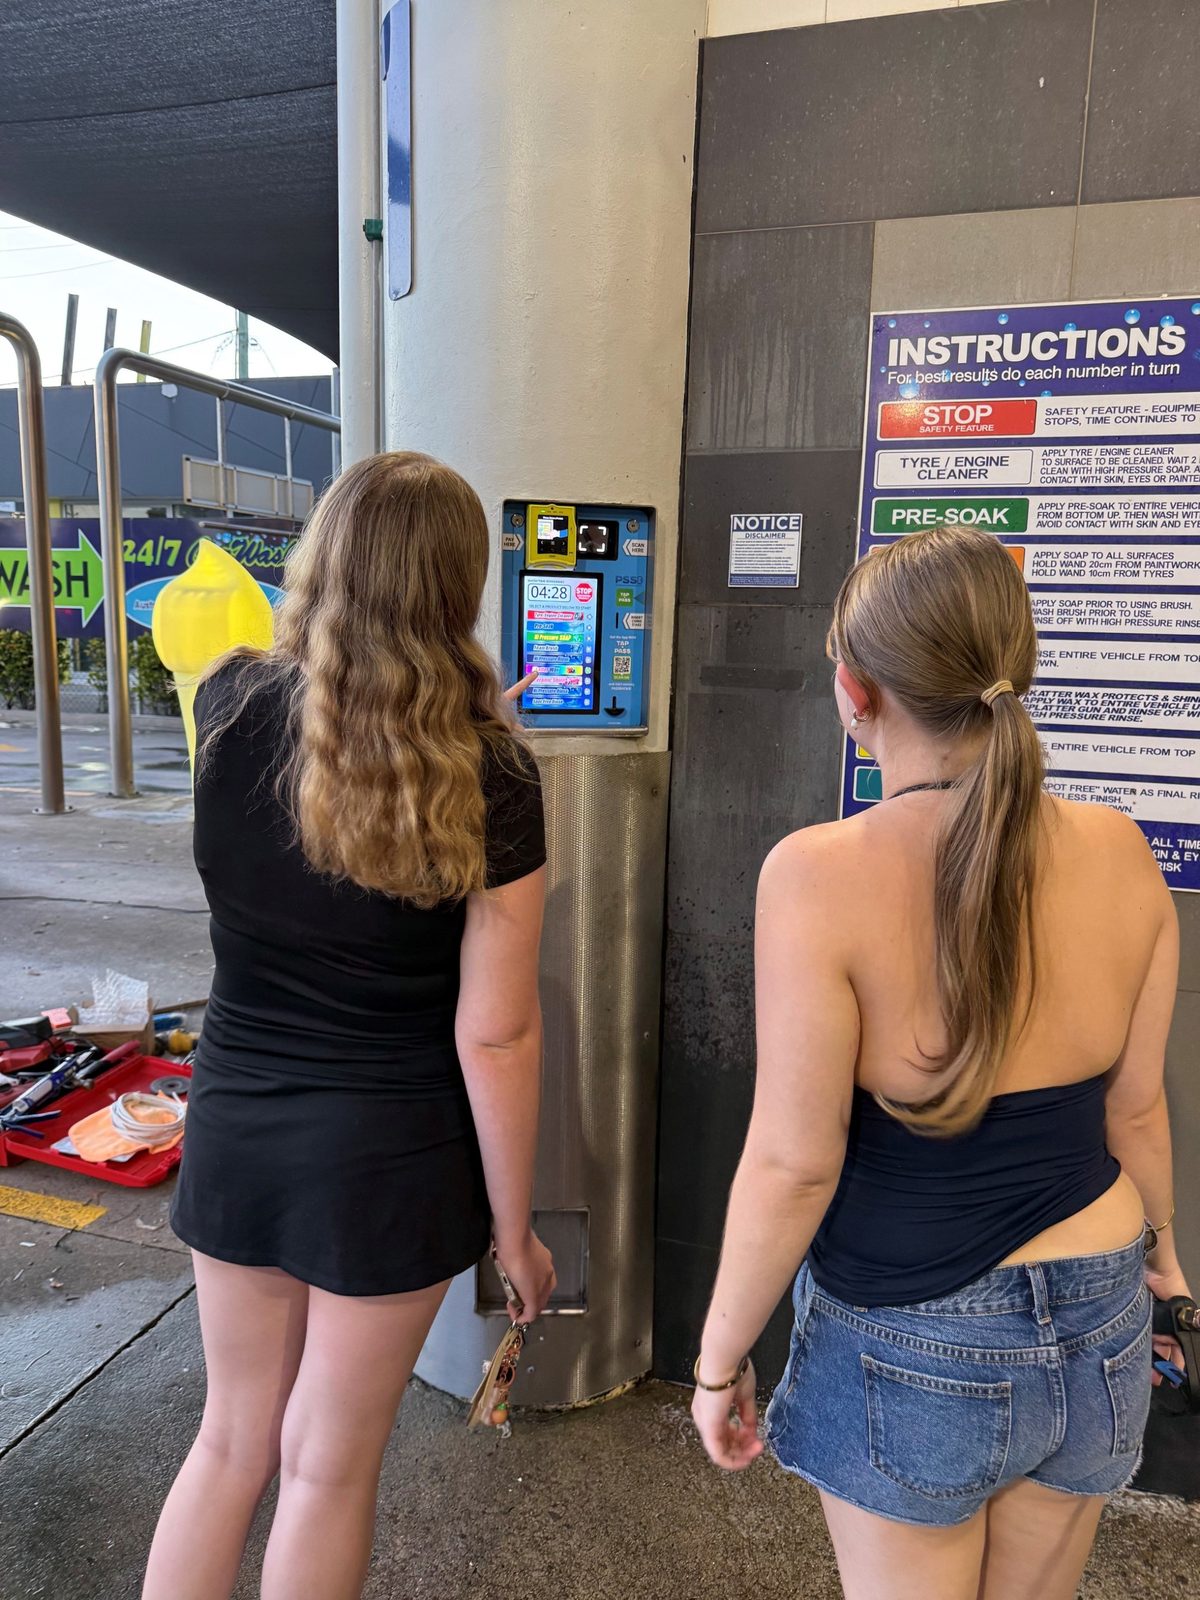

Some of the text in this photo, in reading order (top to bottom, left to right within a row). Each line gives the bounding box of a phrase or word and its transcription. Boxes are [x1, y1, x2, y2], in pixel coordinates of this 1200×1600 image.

[888, 325, 1186, 366] INSTRUCTIONS
[888, 362, 1180, 384] For best results do each number in turn
[923, 405, 992, 425] STOP
[1045, 407, 1088, 416] SAFETY
[1091, 406, 1141, 414] FEATURE
[1044, 414, 1196, 427] STOPS, TIME CONTINUES TO
[919, 424, 994, 433] SAFETY FEATURE
[1042, 448, 1067, 457] APPLY
[1070, 448, 1093, 456] TYRE
[1100, 448, 1131, 456] ENGINE
[1133, 447, 1174, 455] CLEANER
[900, 456, 1009, 468] TYRE / ENGINE
[1042, 458, 1052, 466] TO
[1054, 457, 1092, 465] SURFACE
[1095, 457, 1106, 465] TO
[1108, 457, 1120, 465] BE
[1123, 457, 1164, 465] CLEANED.
[1167, 456, 1189, 464] WAIT
[1191, 456, 1197, 464] 2
[917, 468, 988, 480] CLEANER
[1040, 467, 1068, 475] CLEAN
[1070, 466, 1092, 474] WITH
[1095, 466, 1115, 474] HIGH
[1117, 466, 1163, 474] PRESSURE
[1166, 465, 1191, 473] SOAP.
[1040, 476, 1078, 484] CONTACT
[1104, 475, 1126, 484] SKIN,
[1128, 475, 1151, 483] EYES
[1153, 475, 1166, 483] OR
[1168, 474, 1200, 482] PAINTE
[1037, 502, 1066, 510] APPLY
[1067, 502, 1115, 510] PRE-SOAK
[891, 508, 1009, 526] PRE-SOAK
[1124, 511, 1148, 519] THEN
[1151, 511, 1178, 519] WASH
[1182, 511, 1200, 519] WIT
[733, 516, 800, 530] NOTICE
[1036, 520, 1063, 528] AVOID
[1065, 520, 1107, 528] CONTACT
[1109, 520, 1133, 528] WITH
[1136, 520, 1158, 528] SKIN
[1160, 520, 1181, 528] AND
[122, 535, 182, 567] 24/7
[1126, 552, 1174, 560] SURFACES
[1115, 561, 1142, 569] FROM
[1144, 561, 1200, 569] PAINTWORK
[1031, 569, 1056, 577] HOLD
[1059, 569, 1086, 577] WAND
[1143, 570, 1174, 578] TYRES
[531, 586, 567, 599] 04:28
[1058, 600, 1083, 608] SOAP
[1085, 600, 1113, 608] PRIOR
[1130, 601, 1157, 609] USING
[1160, 602, 1193, 610] BRUSH.
[1089, 609, 1116, 617] PRIOR
[1133, 610, 1154, 618] USE.
[1076, 617, 1099, 625] WITH
[1100, 618, 1122, 626] HIGH
[1124, 619, 1173, 627] PRESSURE
[1059, 651, 1097, 659] ENTIRE
[1100, 652, 1145, 660] VEHICLE
[1148, 653, 1180, 662] FROM
[1101, 693, 1158, 701] PROTECTS
[1173, 695, 1200, 703] SHIN
[1100, 700, 1140, 708] ENTIRE
[1143, 701, 1191, 710] VEHICLE
[1077, 705, 1101, 713] GUN
[1102, 707, 1125, 715] AND
[1127, 708, 1161, 716] RINSE
[1049, 712, 1105, 720] PRESSURE
[1108, 715, 1143, 723] RINSE.
[1051, 742, 1088, 752] ENTIRE
[1092, 744, 1136, 754] VEHICLE
[1139, 747, 1171, 756] FROM
[1174, 749, 1196, 757] TOP
[1103, 786, 1137, 795] WATER
[1140, 788, 1154, 796] AS
[1157, 790, 1186, 799] FINAL
[1090, 795, 1123, 804] FINISH.
[1151, 838, 1173, 848] ALL
[1172, 850, 1181, 860] &
